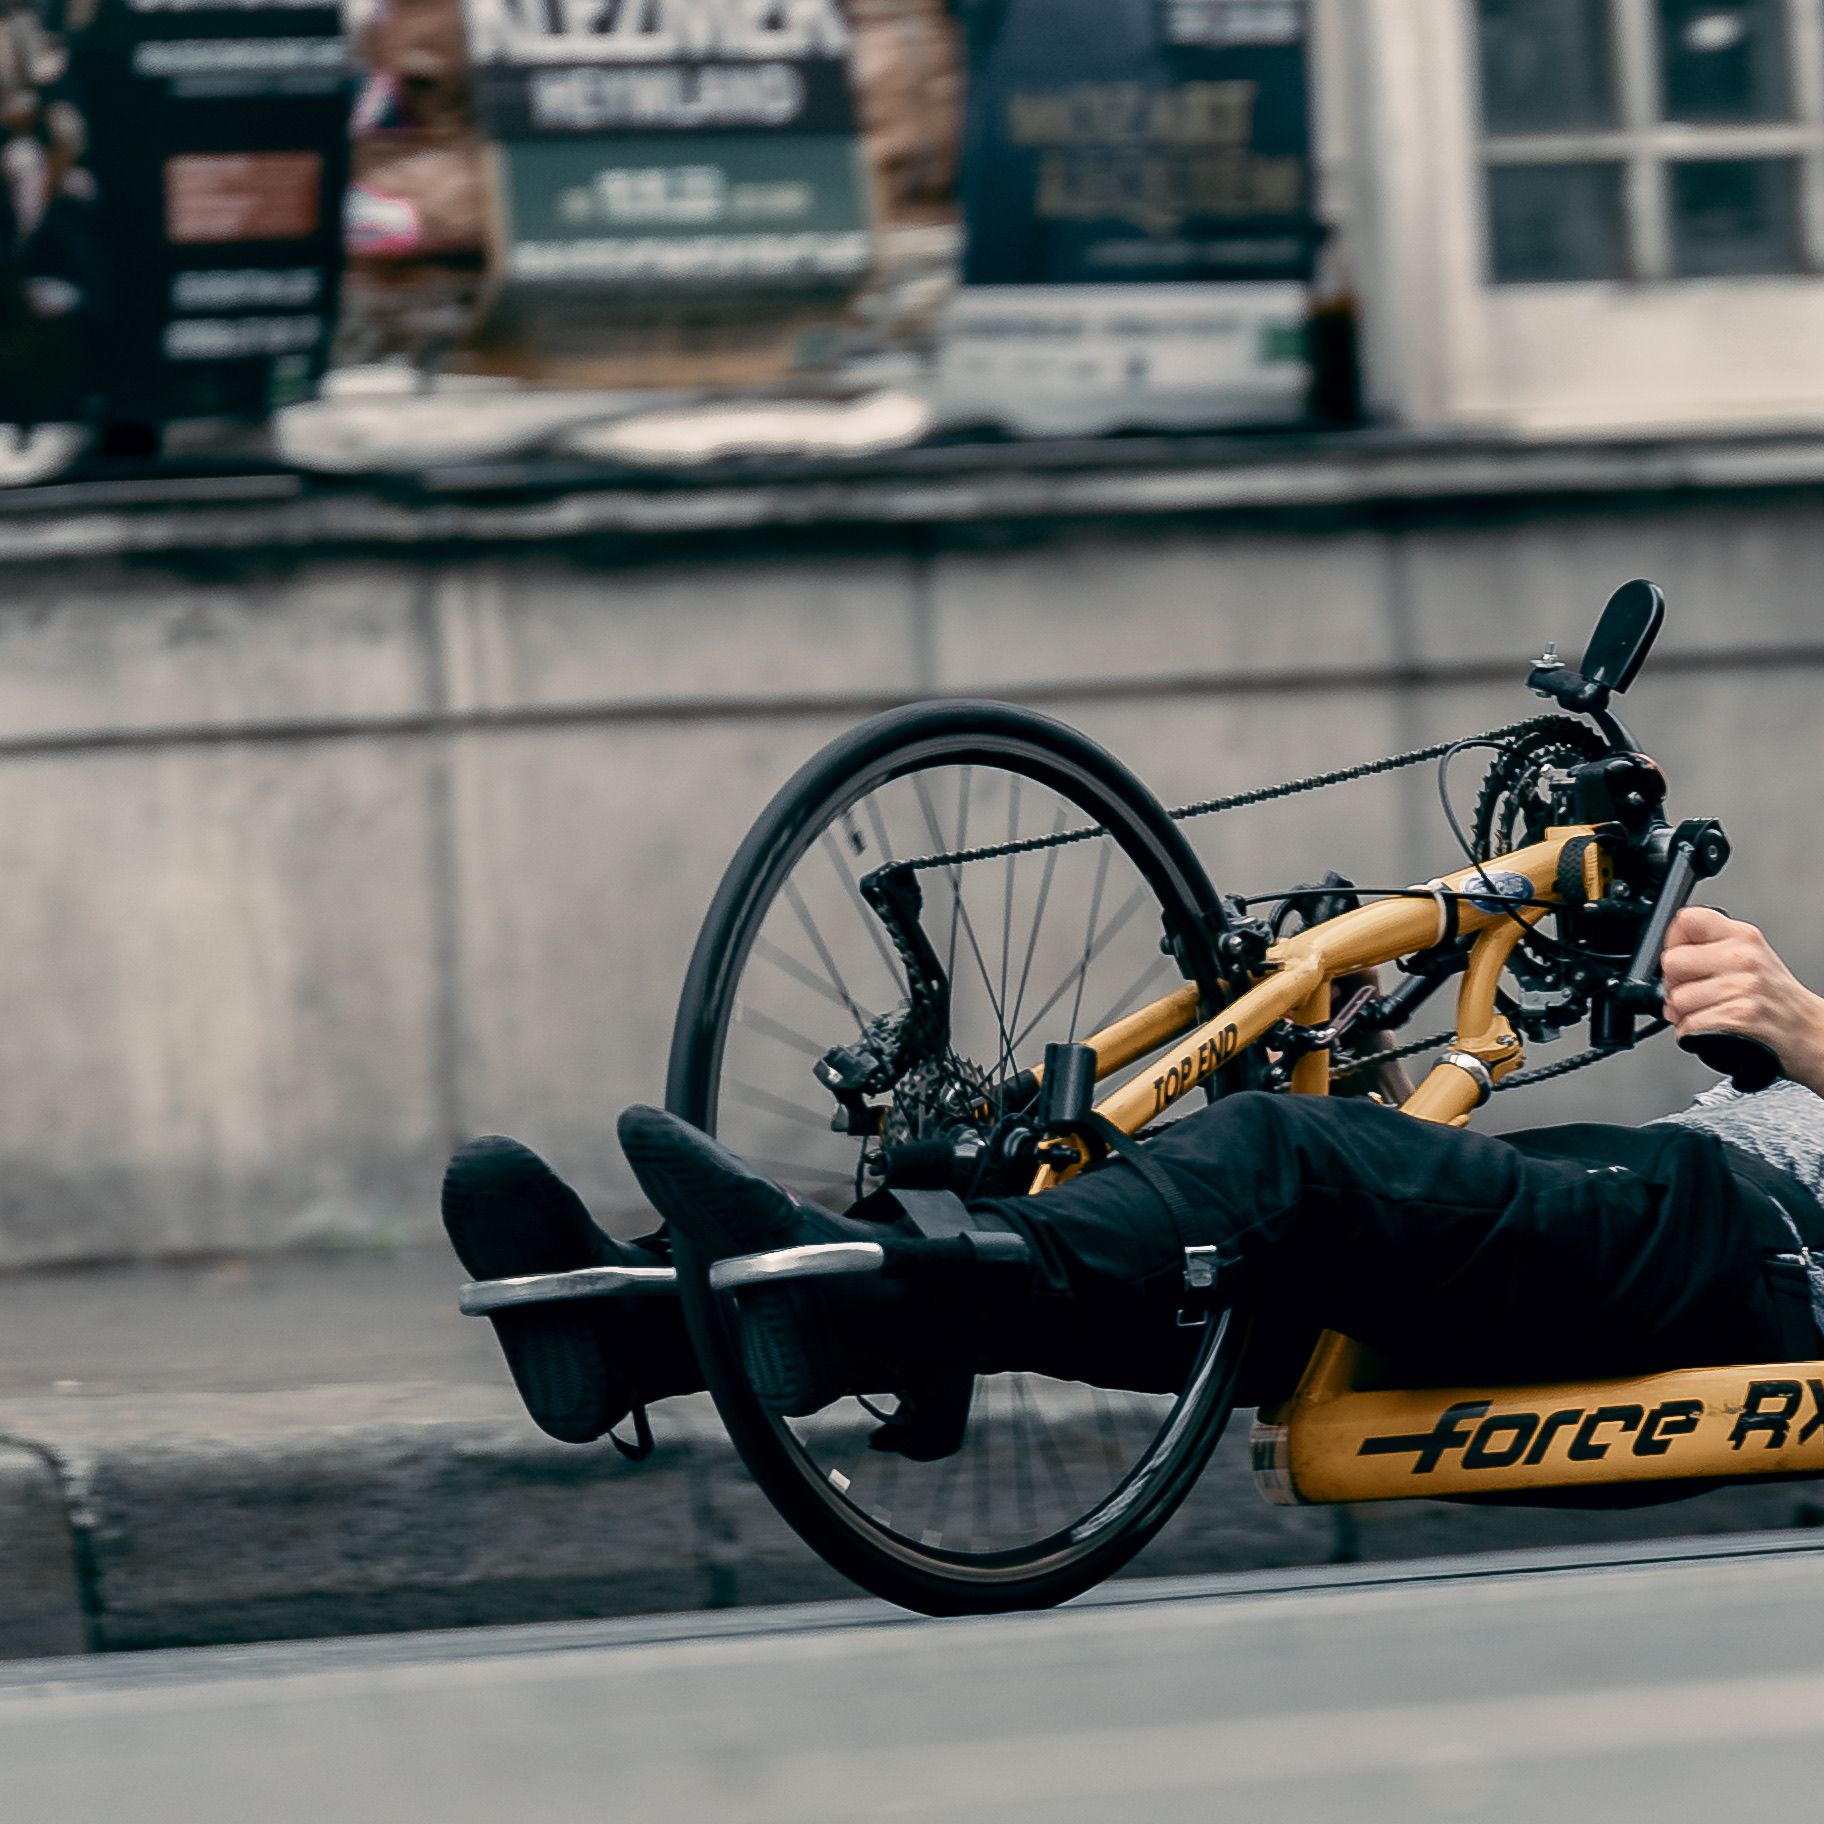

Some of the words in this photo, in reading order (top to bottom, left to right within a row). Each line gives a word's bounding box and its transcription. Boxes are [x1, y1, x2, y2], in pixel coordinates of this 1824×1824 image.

[1152, 1056, 1195, 1114] TOP
[1197, 1023, 1238, 1076] END
[1357, 1399, 1704, 1474] force
